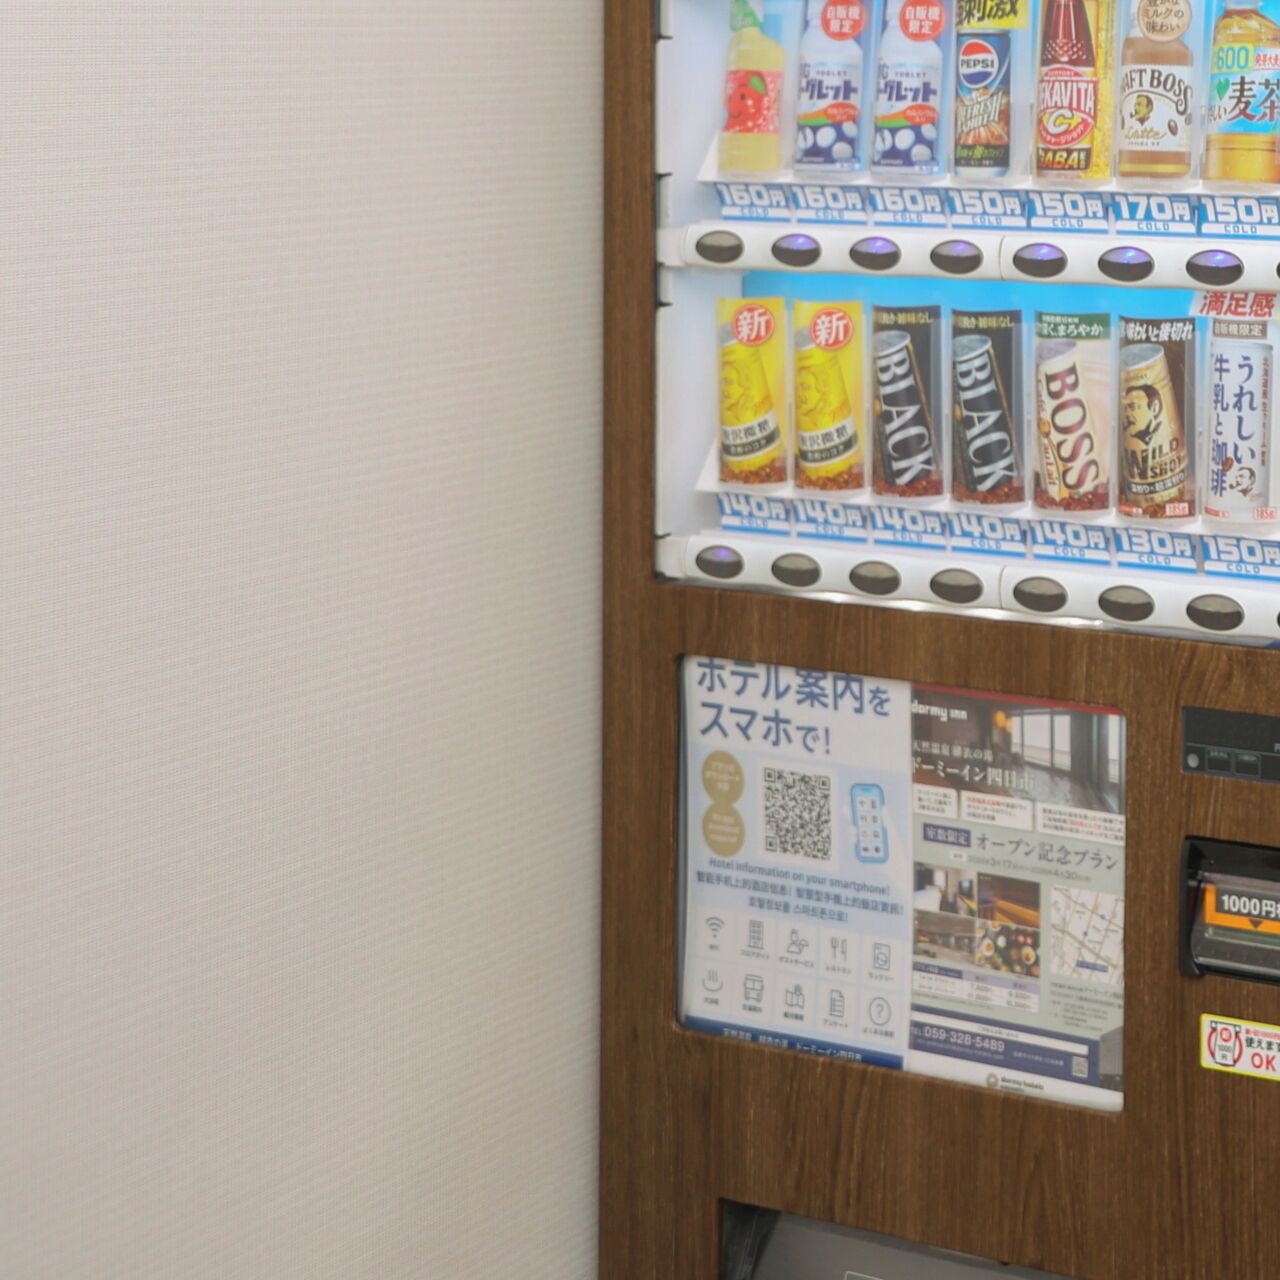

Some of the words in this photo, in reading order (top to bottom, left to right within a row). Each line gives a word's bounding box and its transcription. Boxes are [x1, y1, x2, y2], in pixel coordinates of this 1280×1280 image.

[1114, 195, 1192, 221] 170円
[1202, 291, 1276, 317] 満足感
[735, 308, 773, 341] 新
[875, 348, 938, 486] BLACK
[1233, 355, 1259, 463] うれしい
[1045, 361, 1101, 493] BOSS
[1116, 527, 1192, 555] 130円
[696, 657, 891, 716] ホテル案内を
[700, 701, 831, 754] スマホで!
[709, 858, 735, 870] Hotel
[736, 861, 791, 879] information
[792, 872, 804, 881] on
[806, 875, 828, 886] your
[924, 1025, 1005, 1052] 059-328-5489
[1251, 1052, 1276, 1072] OK
